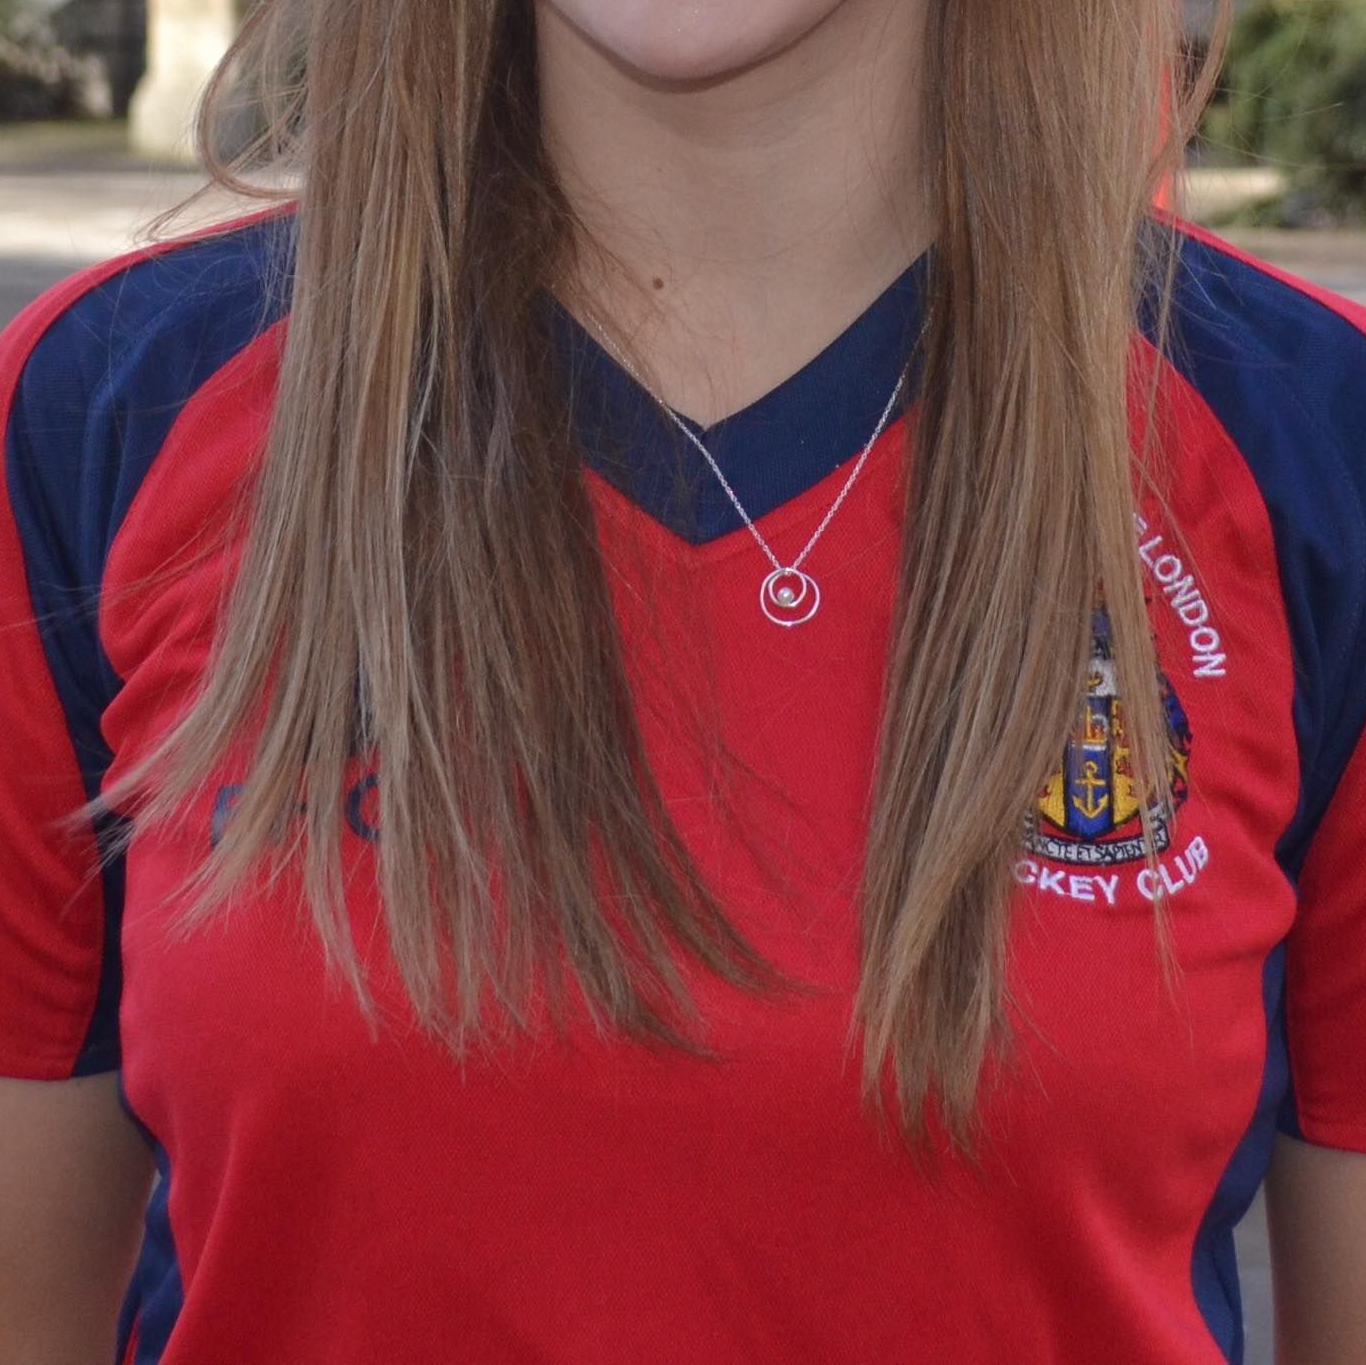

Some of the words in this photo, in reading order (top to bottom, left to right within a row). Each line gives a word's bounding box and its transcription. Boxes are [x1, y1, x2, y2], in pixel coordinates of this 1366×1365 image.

[1138, 534, 1227, 678] LONDON
[1015, 859, 1119, 905] CKEY
[1136, 835, 1210, 901] CLUB
